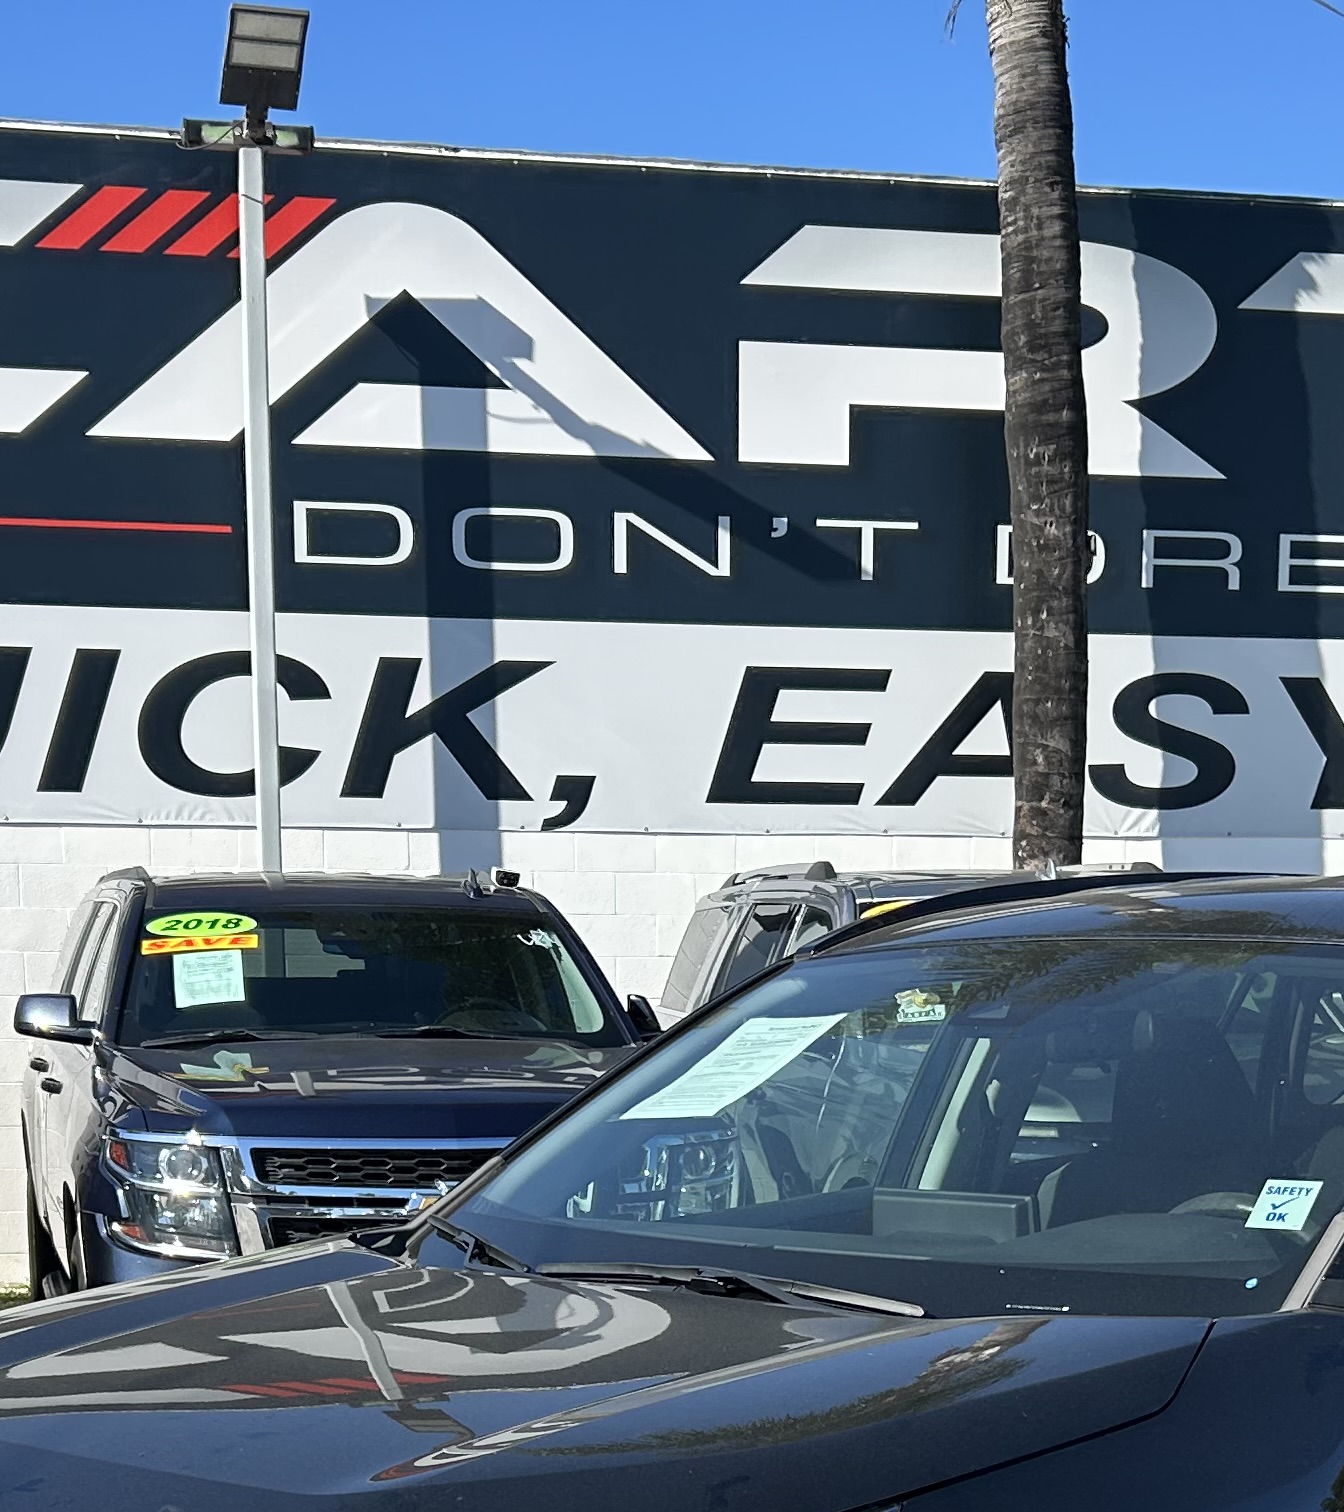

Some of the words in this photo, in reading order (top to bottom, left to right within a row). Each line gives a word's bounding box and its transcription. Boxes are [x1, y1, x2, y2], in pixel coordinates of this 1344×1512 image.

[293, 500, 919, 580] DON'T
[160, 918, 243, 932] 2018
[144, 936, 253, 951] SAVE
[1266, 1186, 1313, 1196] SAFETY
[1266, 1212, 1289, 1222] OK
